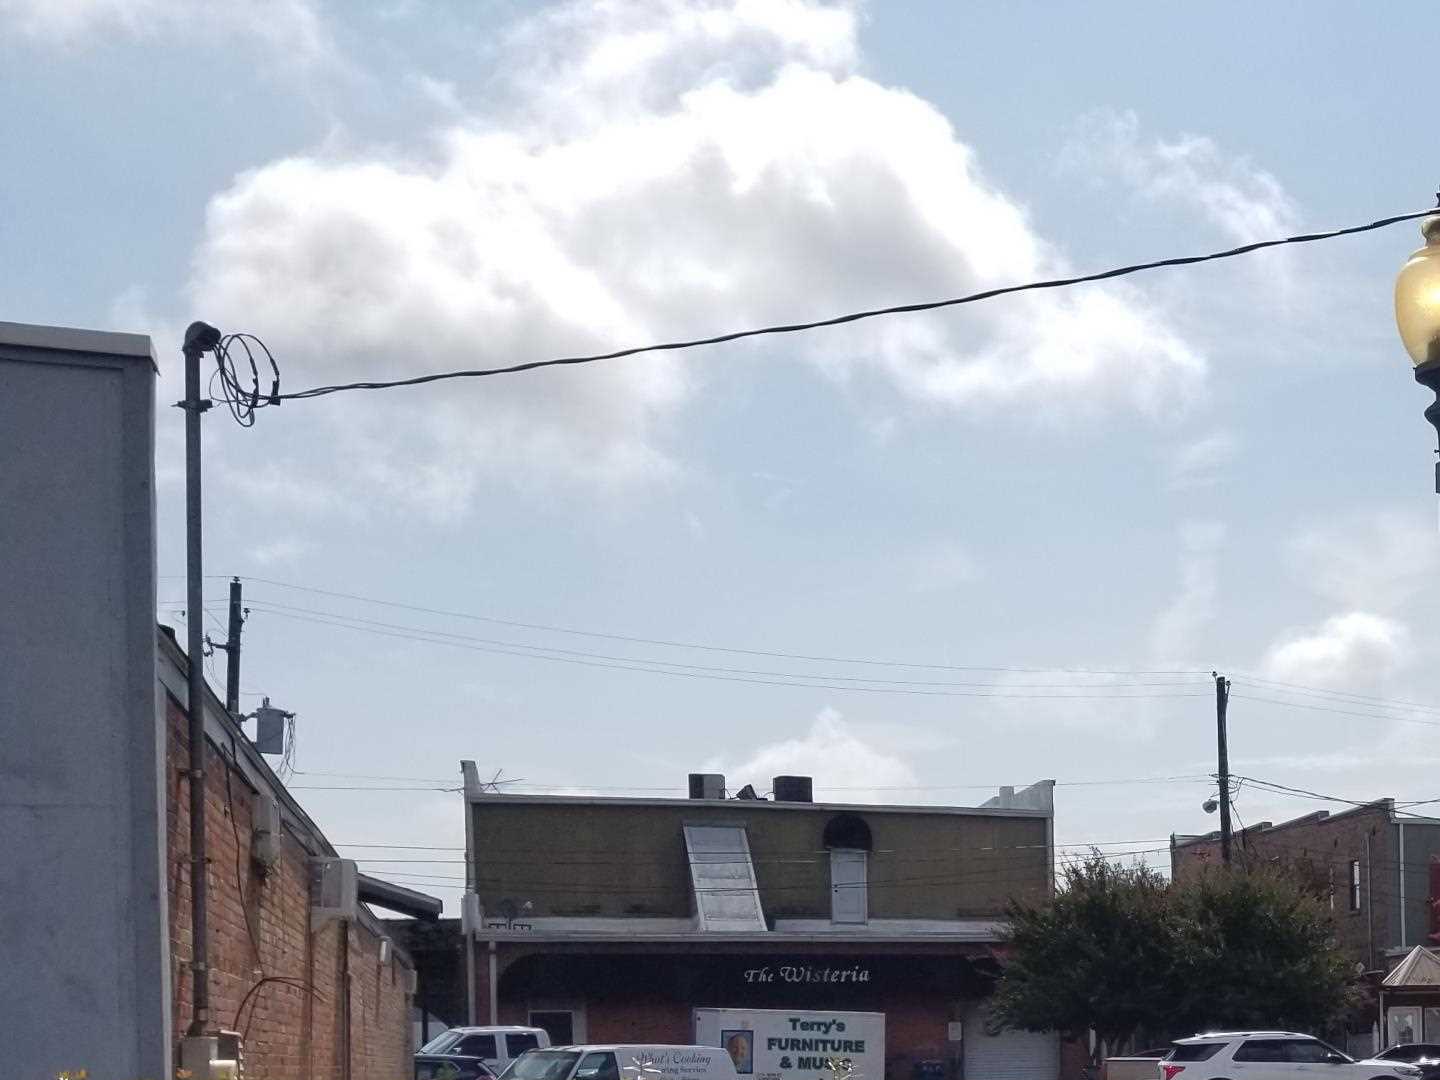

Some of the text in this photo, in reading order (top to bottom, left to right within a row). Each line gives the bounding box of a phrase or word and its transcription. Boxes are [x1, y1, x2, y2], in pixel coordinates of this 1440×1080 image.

[744, 965, 869, 982] The Wisteria
[789, 1018, 845, 1034] Terry's
[767, 1038, 865, 1053] FURNITURE
[780, 1056, 793, 1069] &
